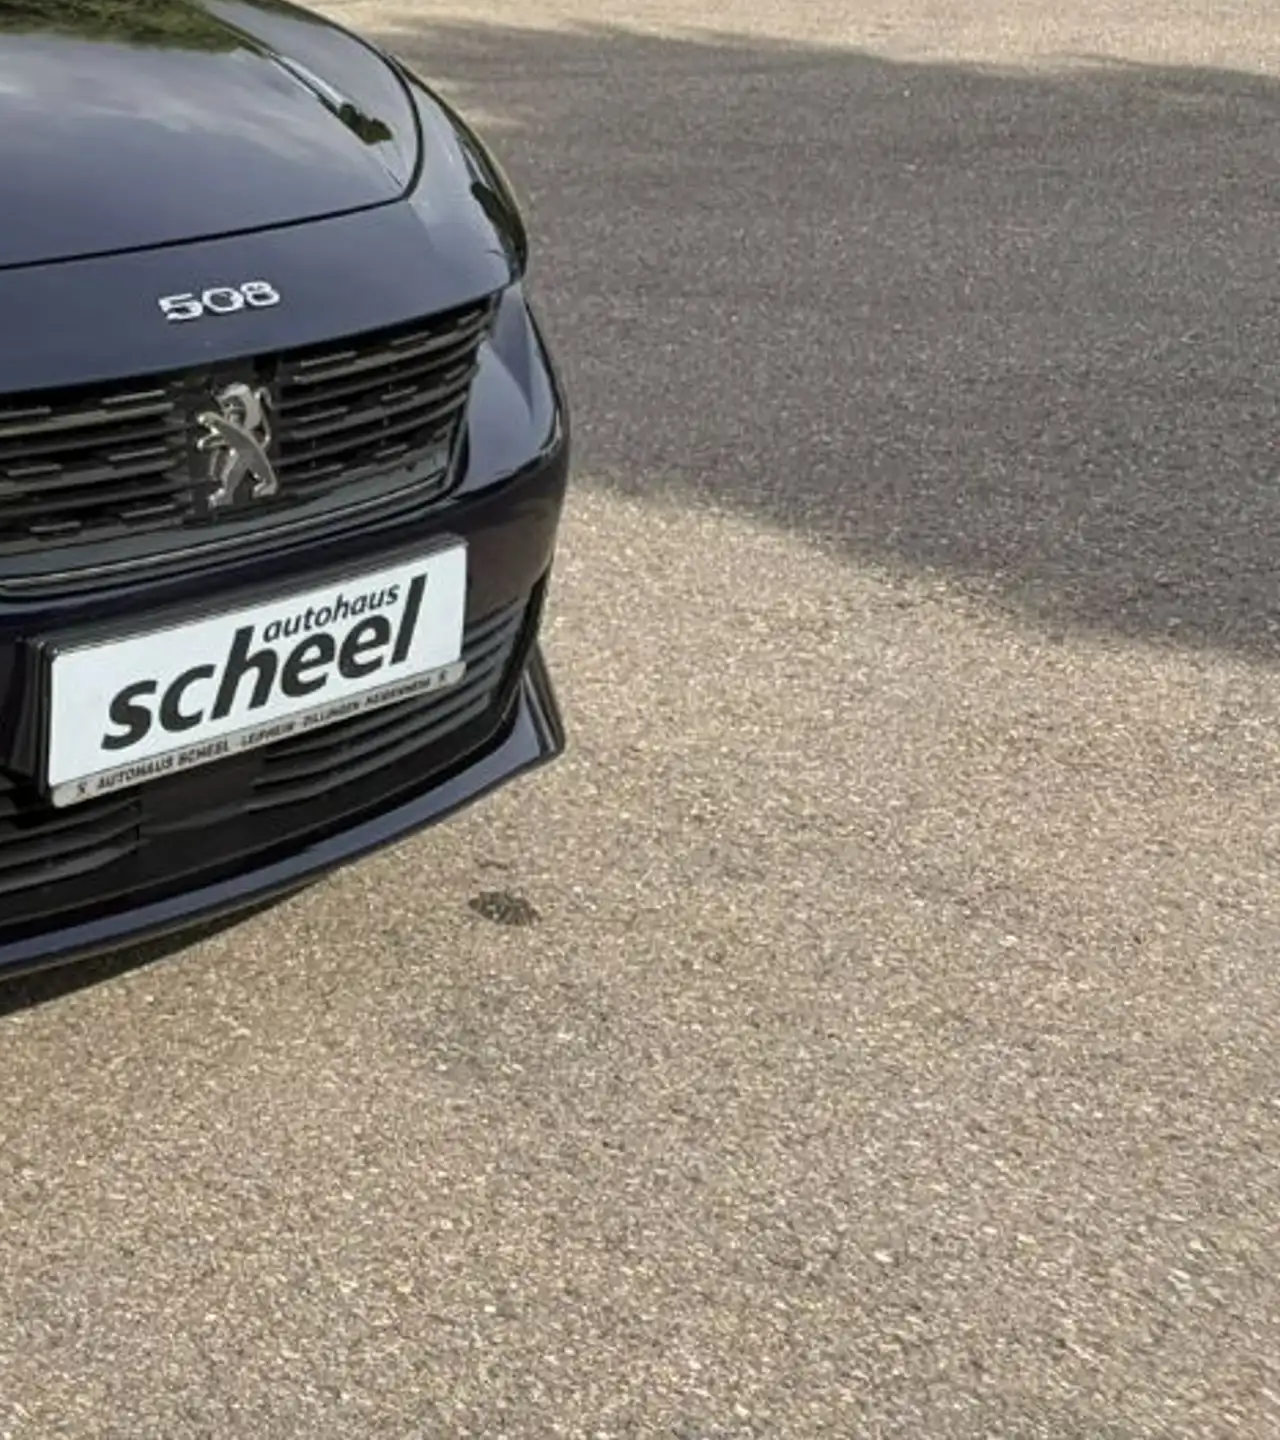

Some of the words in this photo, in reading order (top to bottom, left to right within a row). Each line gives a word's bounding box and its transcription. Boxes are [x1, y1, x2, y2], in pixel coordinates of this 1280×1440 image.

[158, 280, 280, 320] 508
[262, 584, 402, 643] autohaus
[100, 573, 428, 750] scheel
[97, 759, 174, 789] AUTOHAUS
[178, 740, 230, 766] SCHEEL
